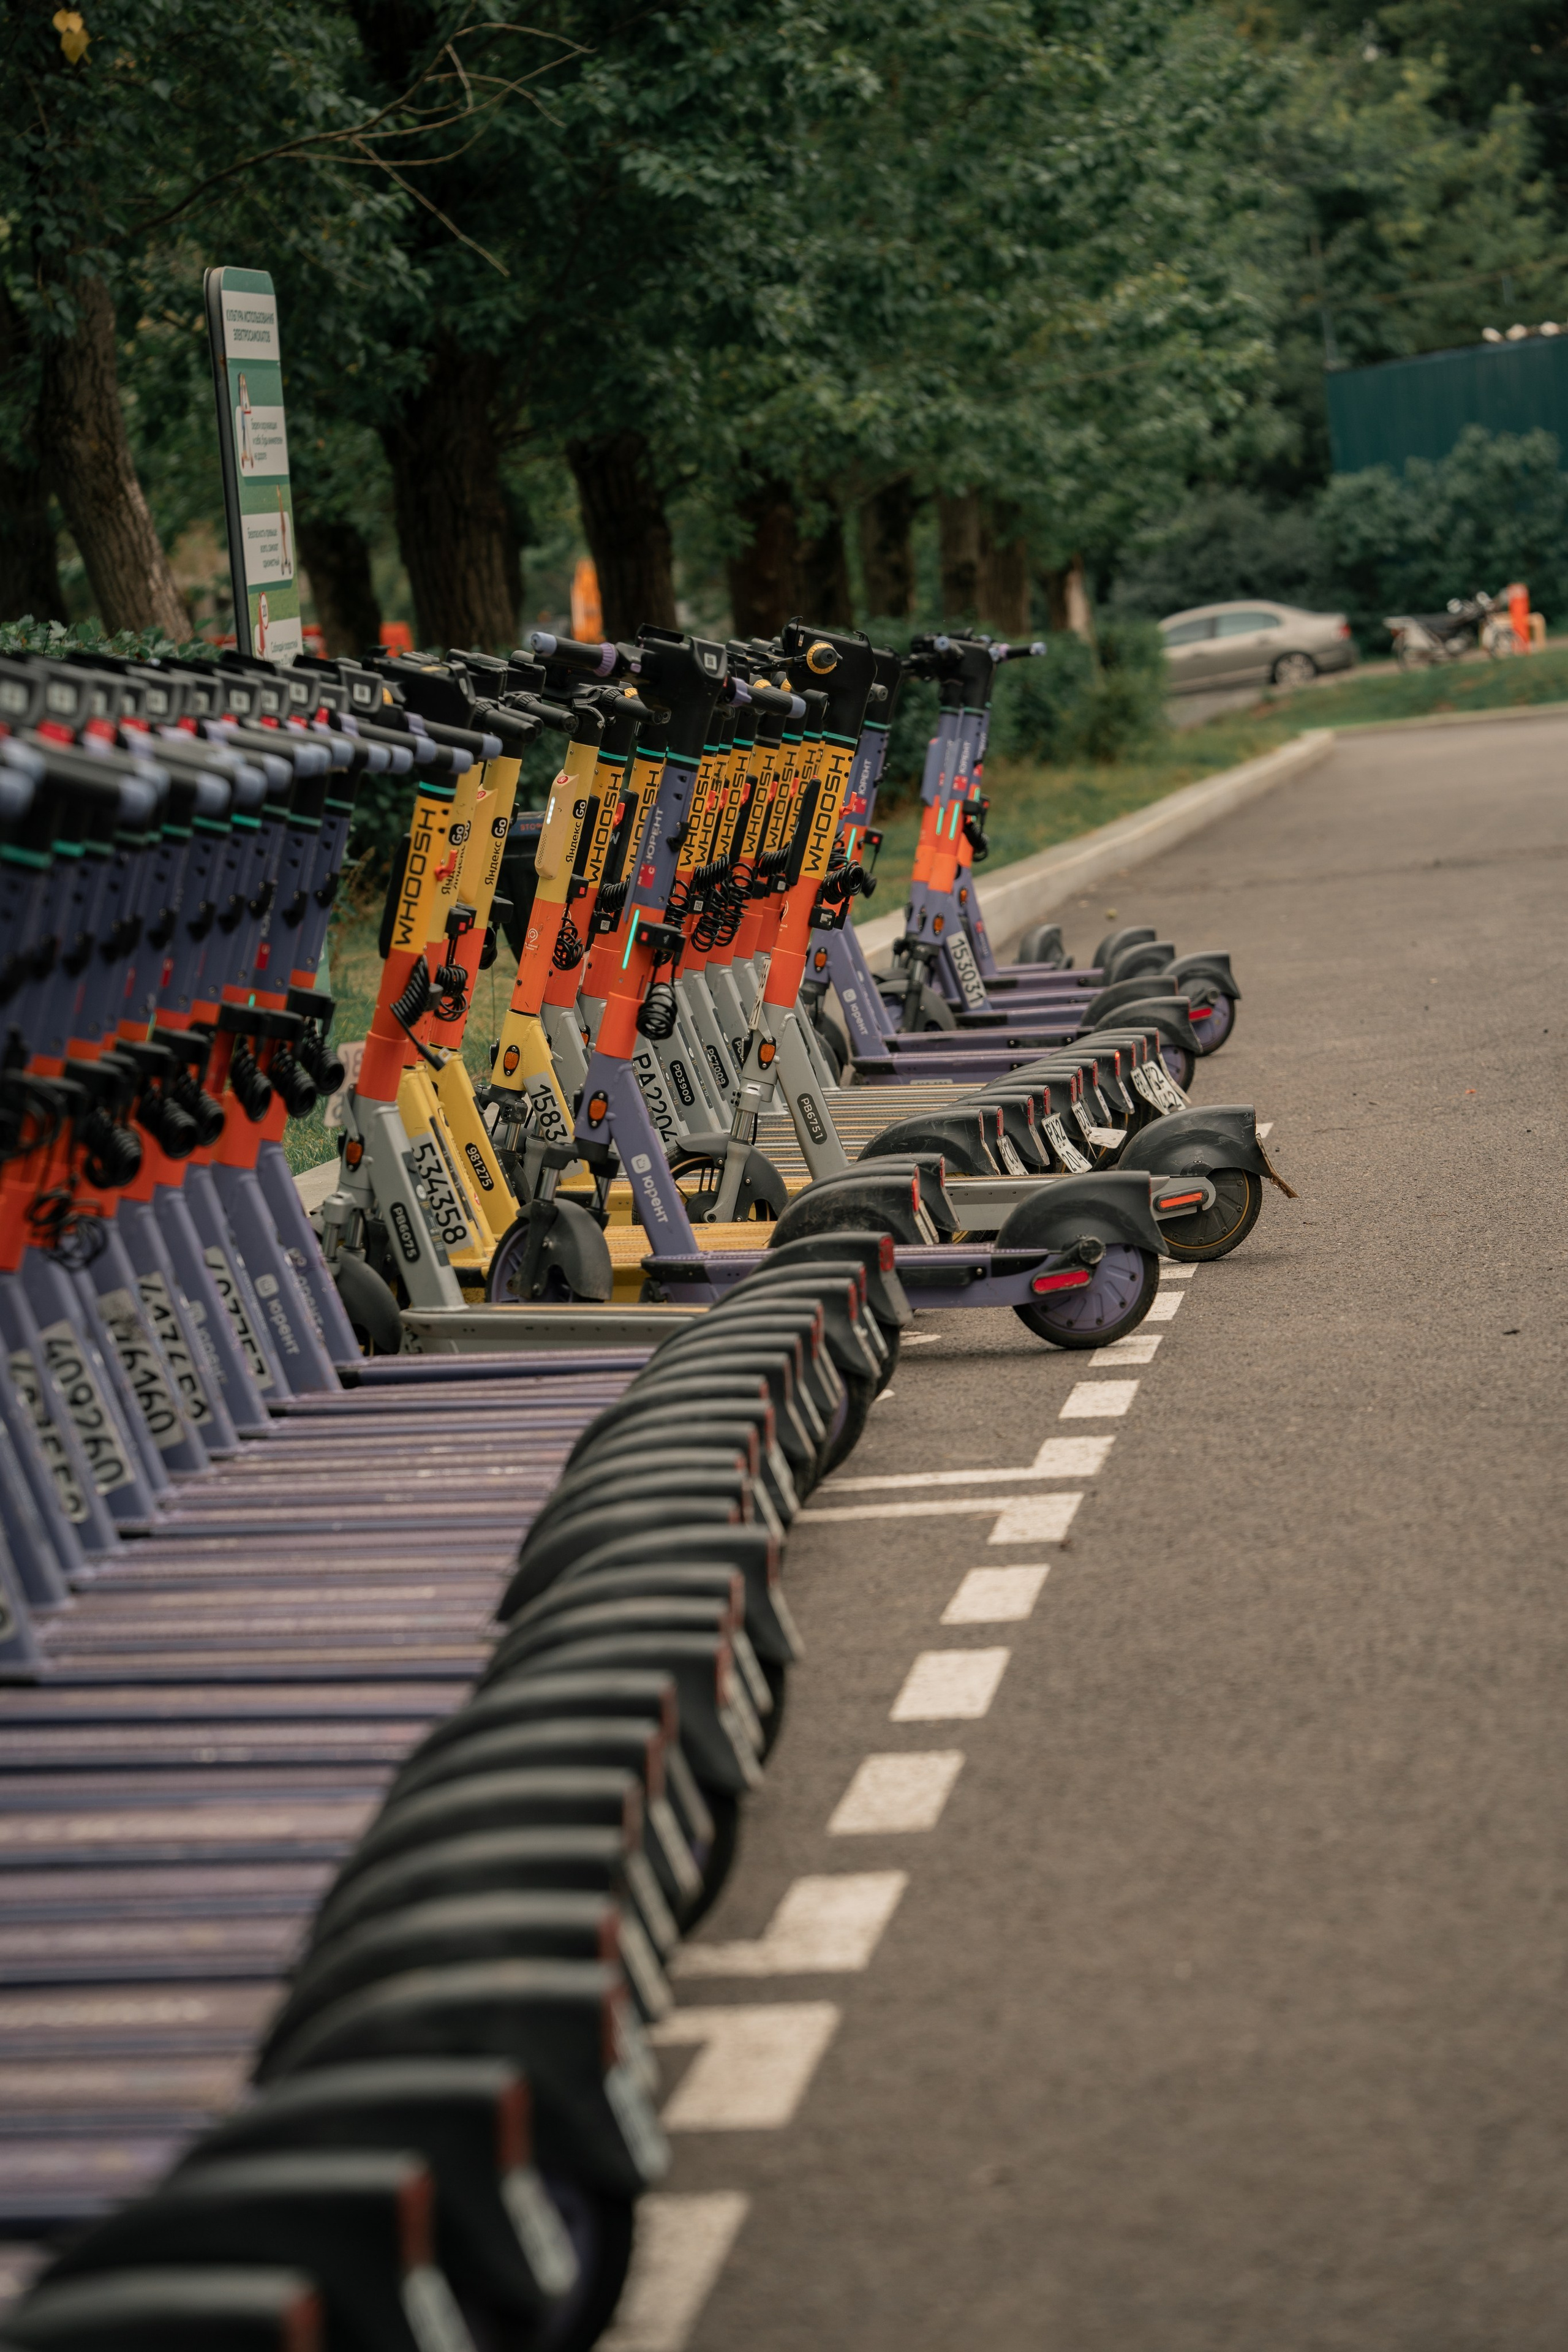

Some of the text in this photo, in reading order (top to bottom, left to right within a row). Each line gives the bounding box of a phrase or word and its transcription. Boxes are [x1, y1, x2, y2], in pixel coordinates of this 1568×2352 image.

[589, 773, 621, 883] WHOOSH
[680, 763, 712, 867] WHOOSH
[743, 755, 775, 853] WHOOSH
[766, 751, 796, 848] WHOOSH
[805, 754, 846, 872] WHOOSH
[451, 826, 464, 844] Go
[485, 819, 507, 885] Яндекс Go
[566, 801, 587, 863] Яндекс Go
[395, 808, 435, 944] WHOOSH
[952, 938, 984, 1003] 153031
[673, 1063, 692, 1102] PD3900
[707, 1048, 726, 1085] PC7009
[801, 1097, 823, 1139] PB6751
[412, 1142, 467, 1245] 534358
[467, 1147, 492, 1187] 981275
[642, 1174, 669, 1224] юрент
[393, 1206, 417, 1258] PB6075
[267, 1298, 300, 1355] юрент
